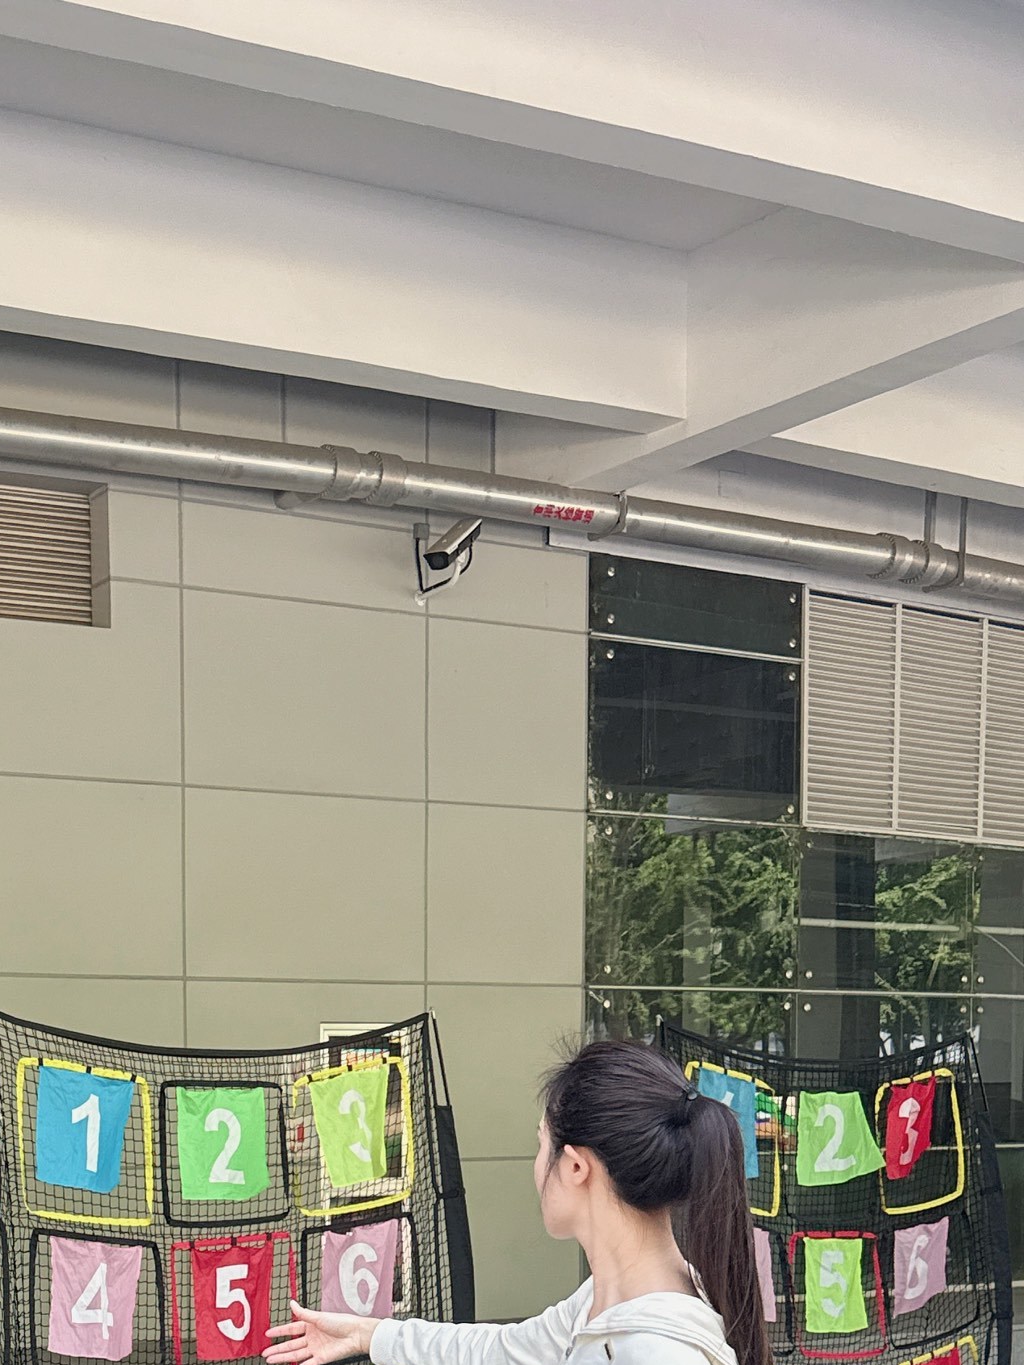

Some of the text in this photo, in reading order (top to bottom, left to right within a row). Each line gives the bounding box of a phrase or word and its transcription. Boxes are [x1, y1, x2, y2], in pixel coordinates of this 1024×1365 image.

[70, 1094, 101, 1173] 1
[203, 1107, 245, 1184] 2
[338, 1088, 372, 1163] 3
[814, 1103, 856, 1173] 2
[897, 1097, 921, 1165] 3
[71, 1262, 114, 1340] 4
[215, 1264, 251, 1341] 5
[338, 1242, 379, 1316] 6
[819, 1249, 848, 1318] 5
[903, 1233, 929, 1300] 6
